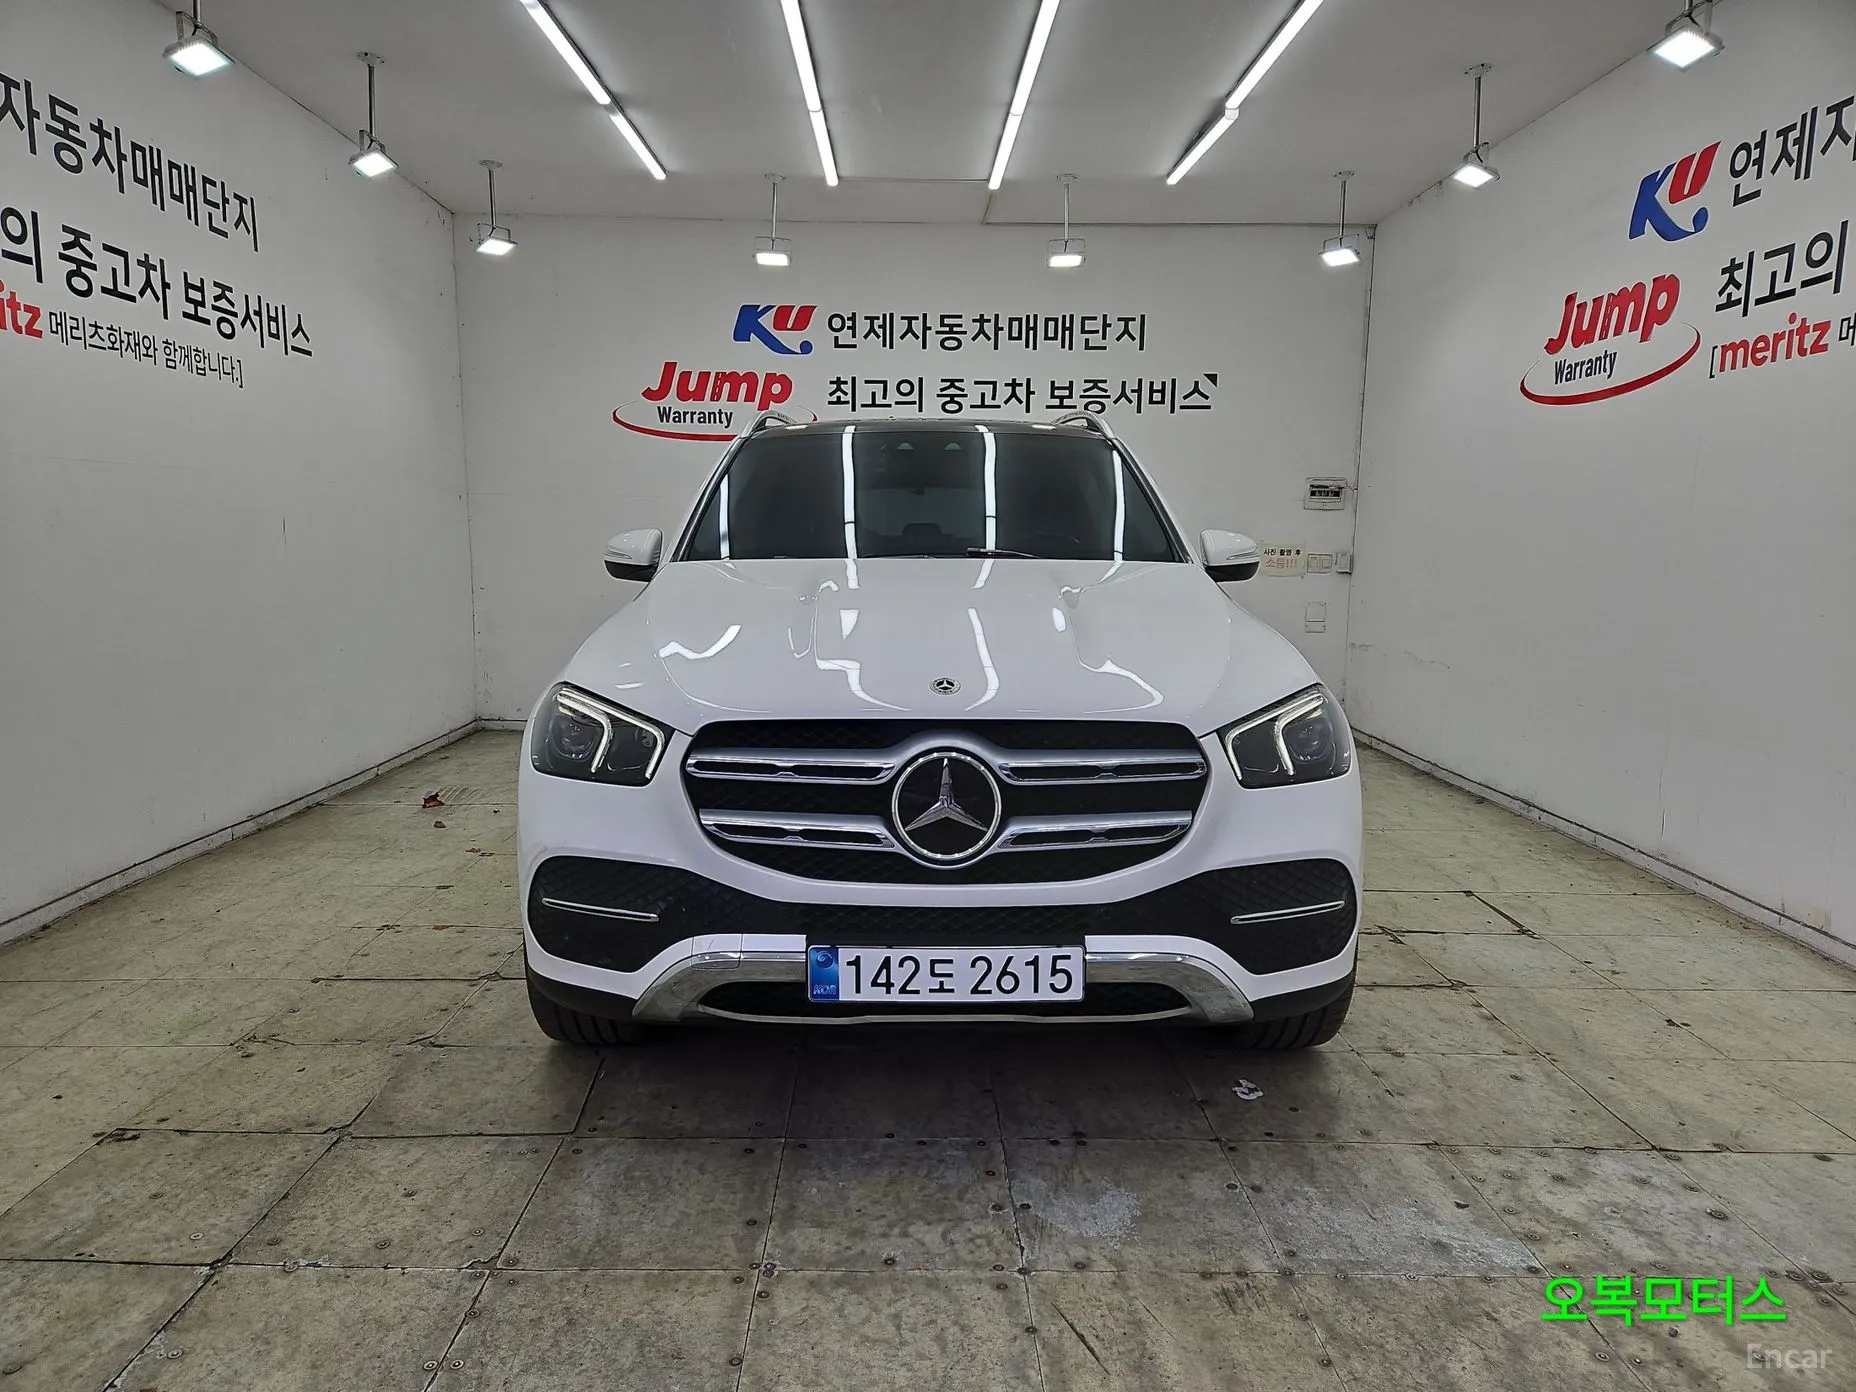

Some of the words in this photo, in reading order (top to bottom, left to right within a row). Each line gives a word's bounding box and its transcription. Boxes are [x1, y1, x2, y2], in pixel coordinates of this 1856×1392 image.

[0, 72, 259, 253] 자동차매매단지
[58, 224, 171, 320] 중고차
[182, 271, 313, 357] 보증서비스
[1715, 220, 1849, 318] 최고의
[827, 311, 1146, 351] 연제자동차매매단지
[1544, 273, 1680, 355] Jump
[49, 310, 158, 365] 메리츠화재와
[162, 338, 244, 389] 함께합니다.]
[1554, 349, 1618, 385] Warranty
[641, 361, 793, 411] Jump
[827, 376, 925, 413] 최고의
[936, 377, 1036, 414] 중고차
[1045, 377, 1212, 414] 보증서비스
[657, 406, 733, 428] Warranty
[845, 954, 955, 995] 142도
[970, 954, 1073, 995] 2615
